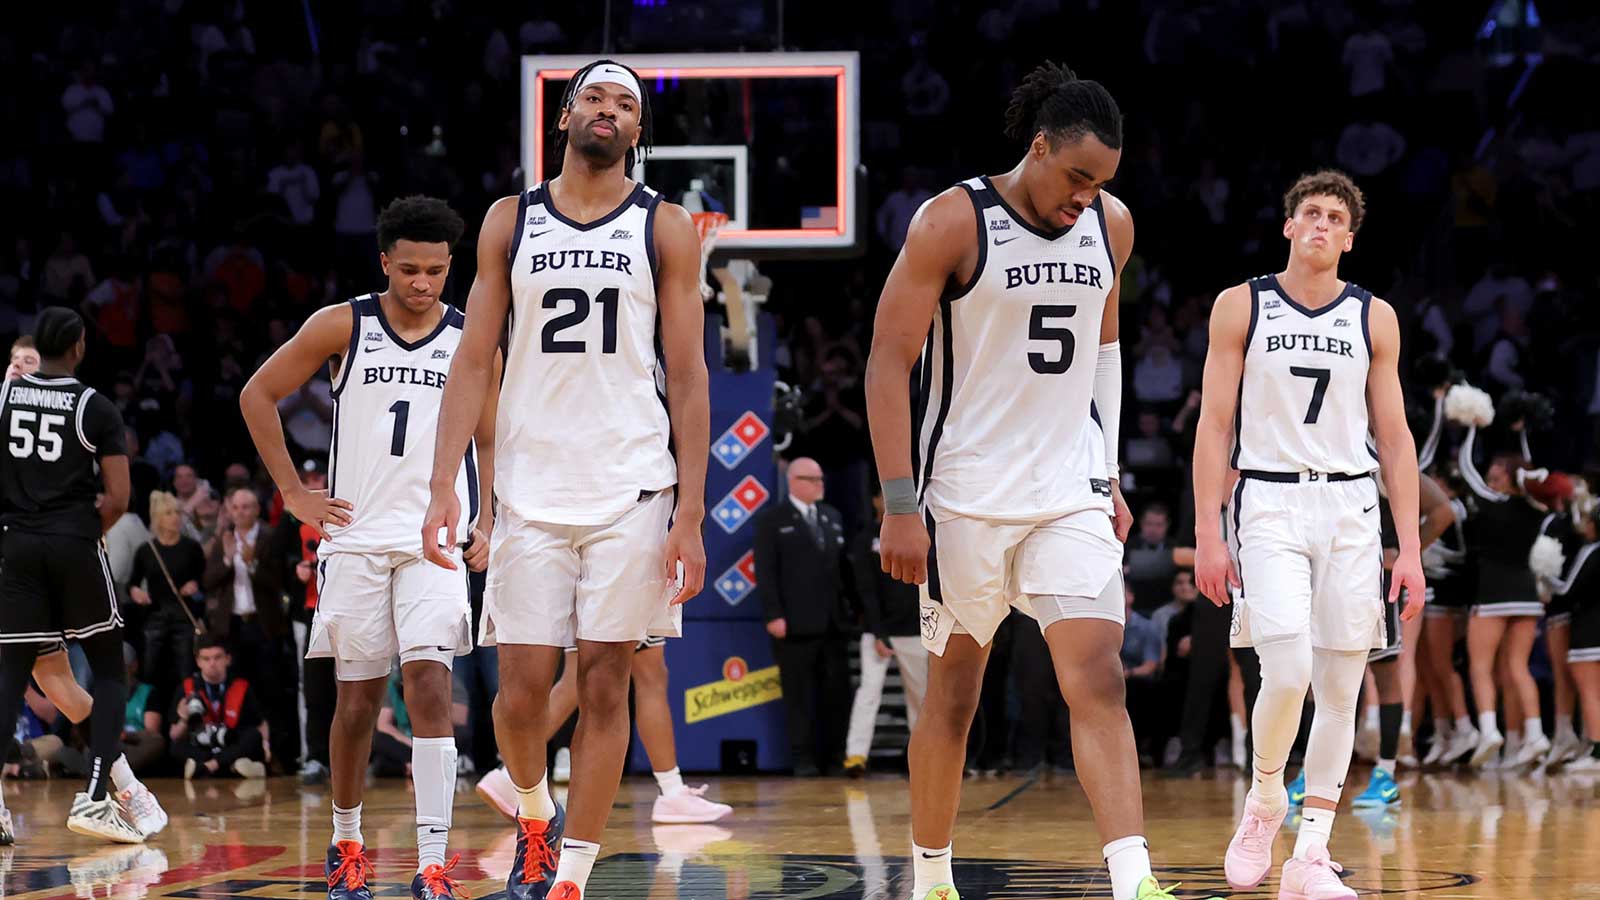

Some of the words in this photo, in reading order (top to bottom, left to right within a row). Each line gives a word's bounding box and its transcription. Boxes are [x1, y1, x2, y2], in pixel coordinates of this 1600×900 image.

[530, 250, 633, 275] BUTLER
[1005, 262, 1103, 290] BUTLER
[541, 287, 620, 354] 21
[1027, 304, 1077, 374] 5
[1266, 334, 1354, 358] BUTLER
[363, 367, 448, 389] BUTLER
[1289, 366, 1331, 424] 7
[8, 409, 66, 462] 55
[389, 400, 410, 457] 1
[1308, 468, 1319, 482] B
